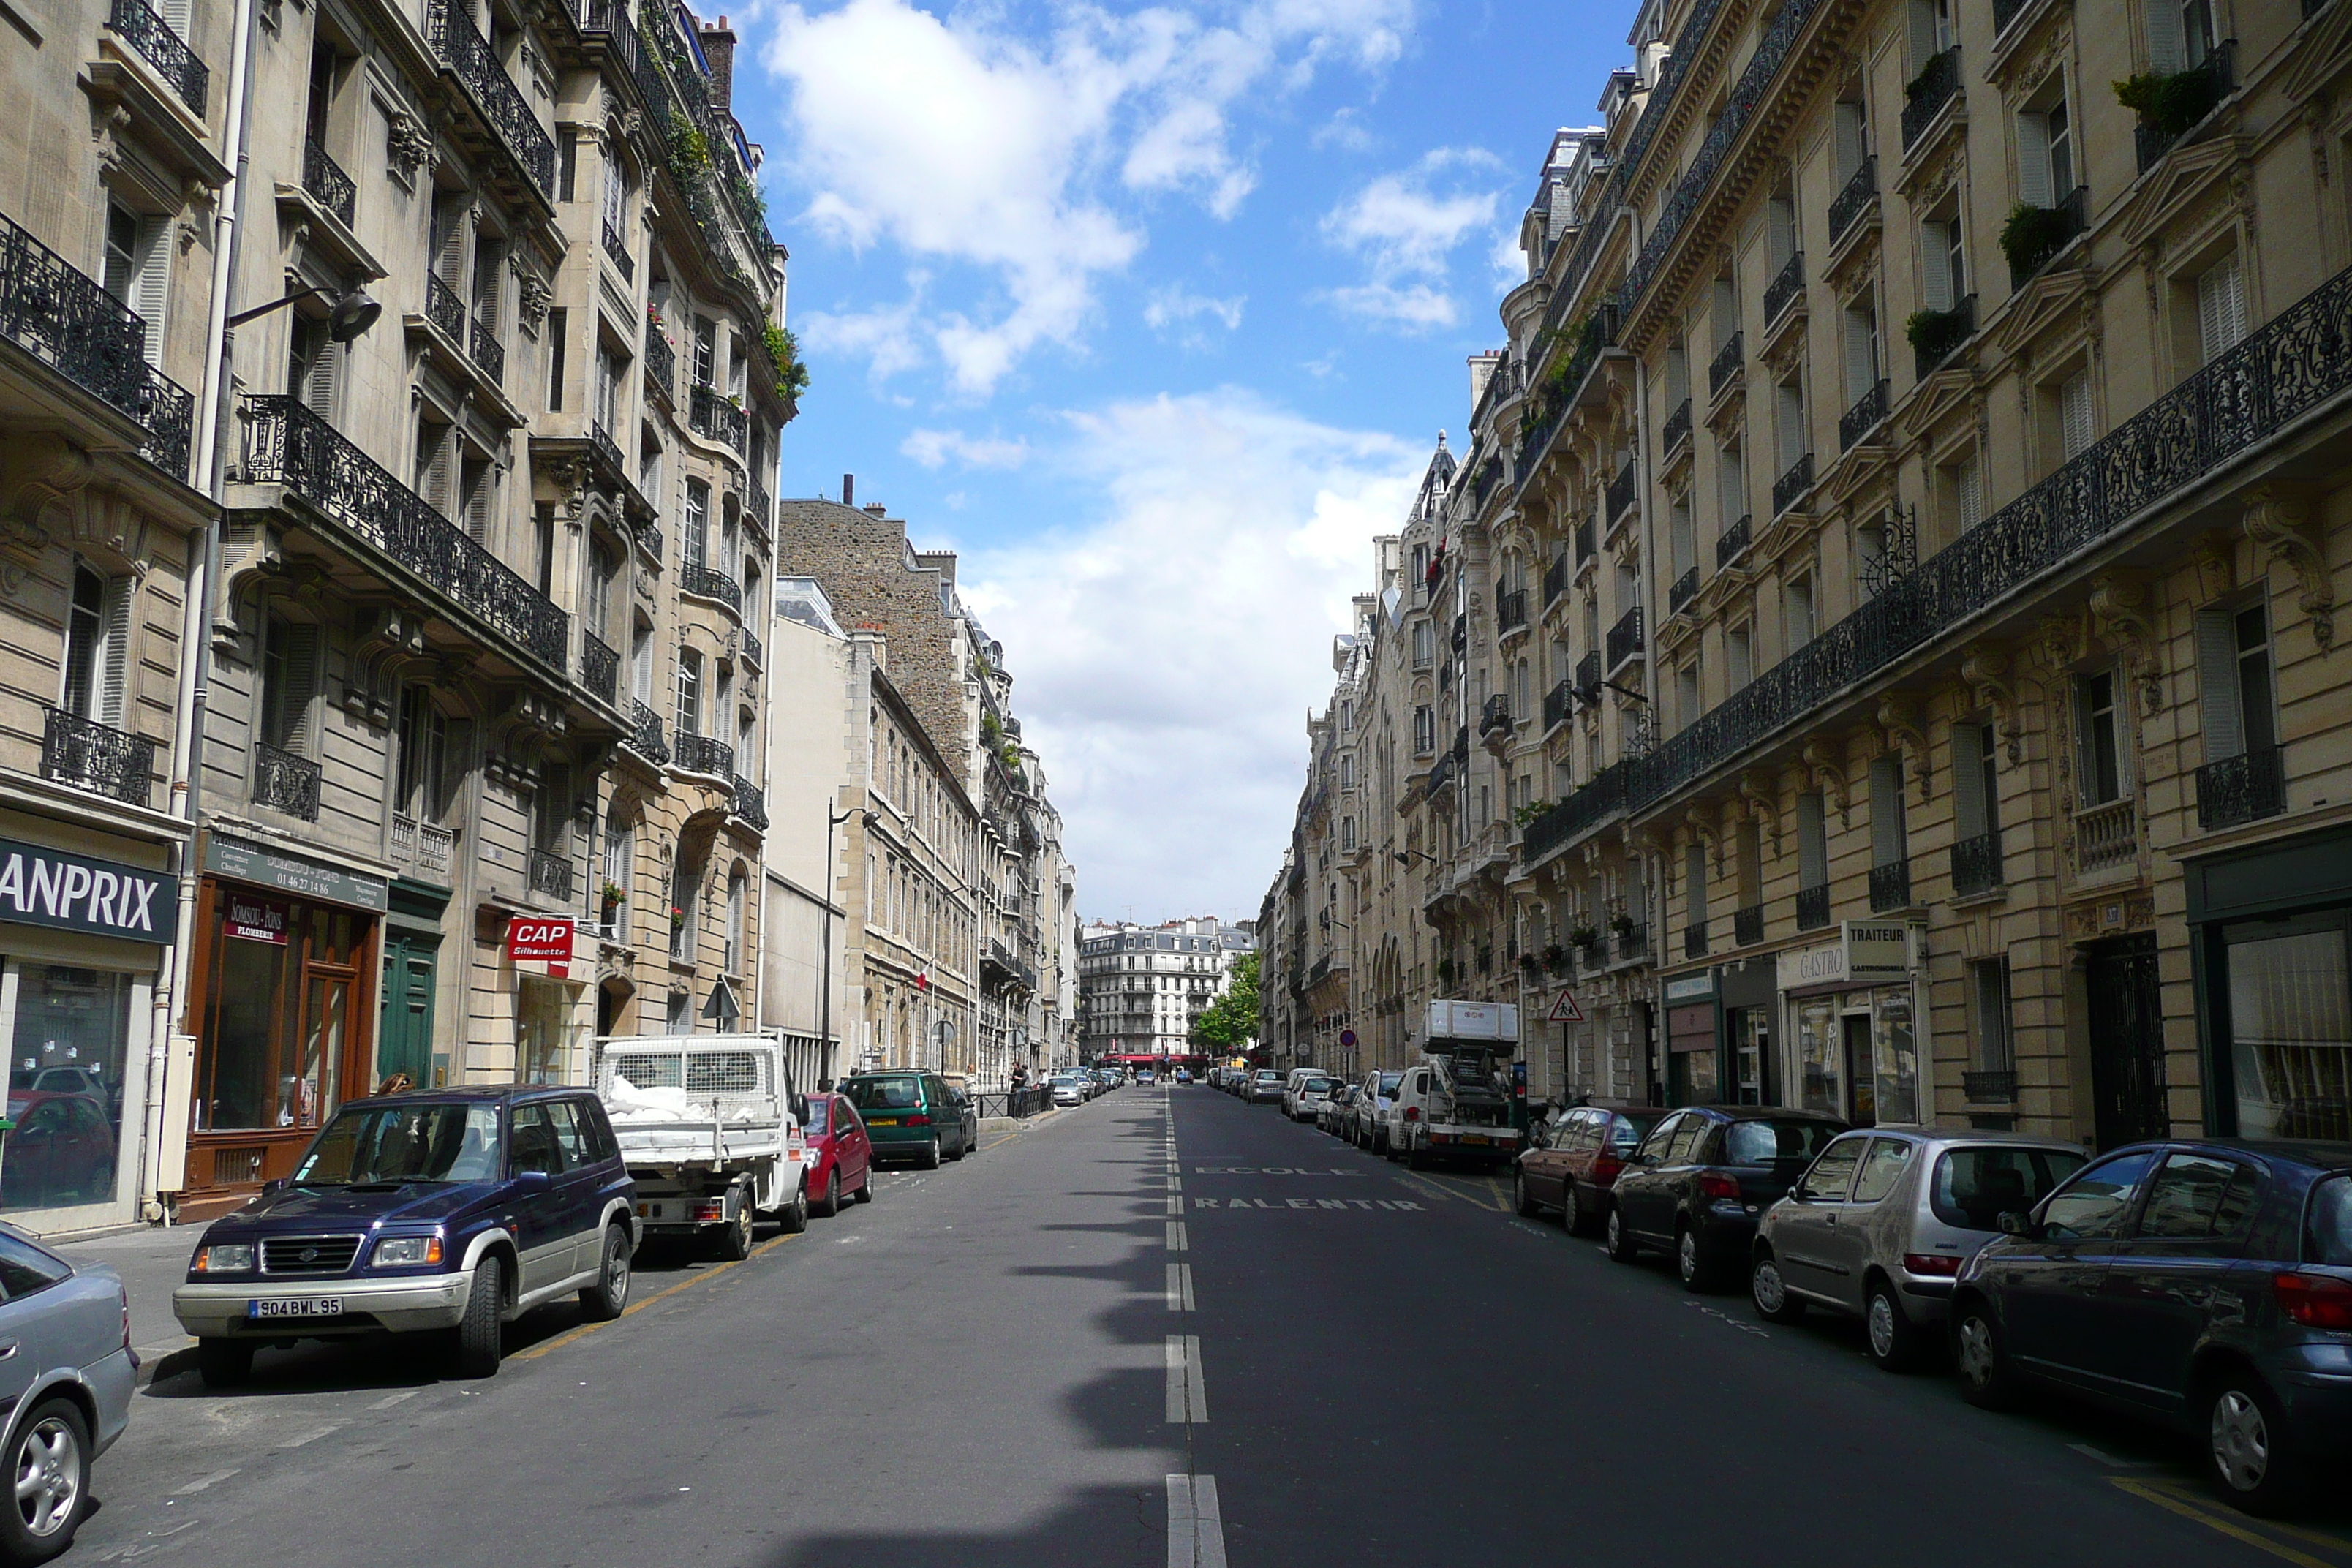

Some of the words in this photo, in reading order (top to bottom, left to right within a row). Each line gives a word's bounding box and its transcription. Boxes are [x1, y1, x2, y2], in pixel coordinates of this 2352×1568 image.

[277, 872, 286, 885] 01
[288, 875, 298, 887] 46
[298, 878, 308, 889] 27
[310, 881, 318, 892] 14
[320, 883, 328, 894] 86
[0, 853, 159, 932] ANPRIX
[238, 925, 274, 940] PLOMBERIE
[516, 924, 566, 943] CAP
[1850, 928, 1904, 942] TRAITEUR
[513, 946, 566, 956] Silhouette
[1851, 965, 1906, 973] GASTRONOMIA
[1195, 1167, 1368, 1176] ECOLE
[1194, 1198, 1428, 1211] RALENTIR
[261, 1302, 287, 1316] 904
[291, 1300, 318, 1315] BWL
[321, 1300, 339, 1313] 95
